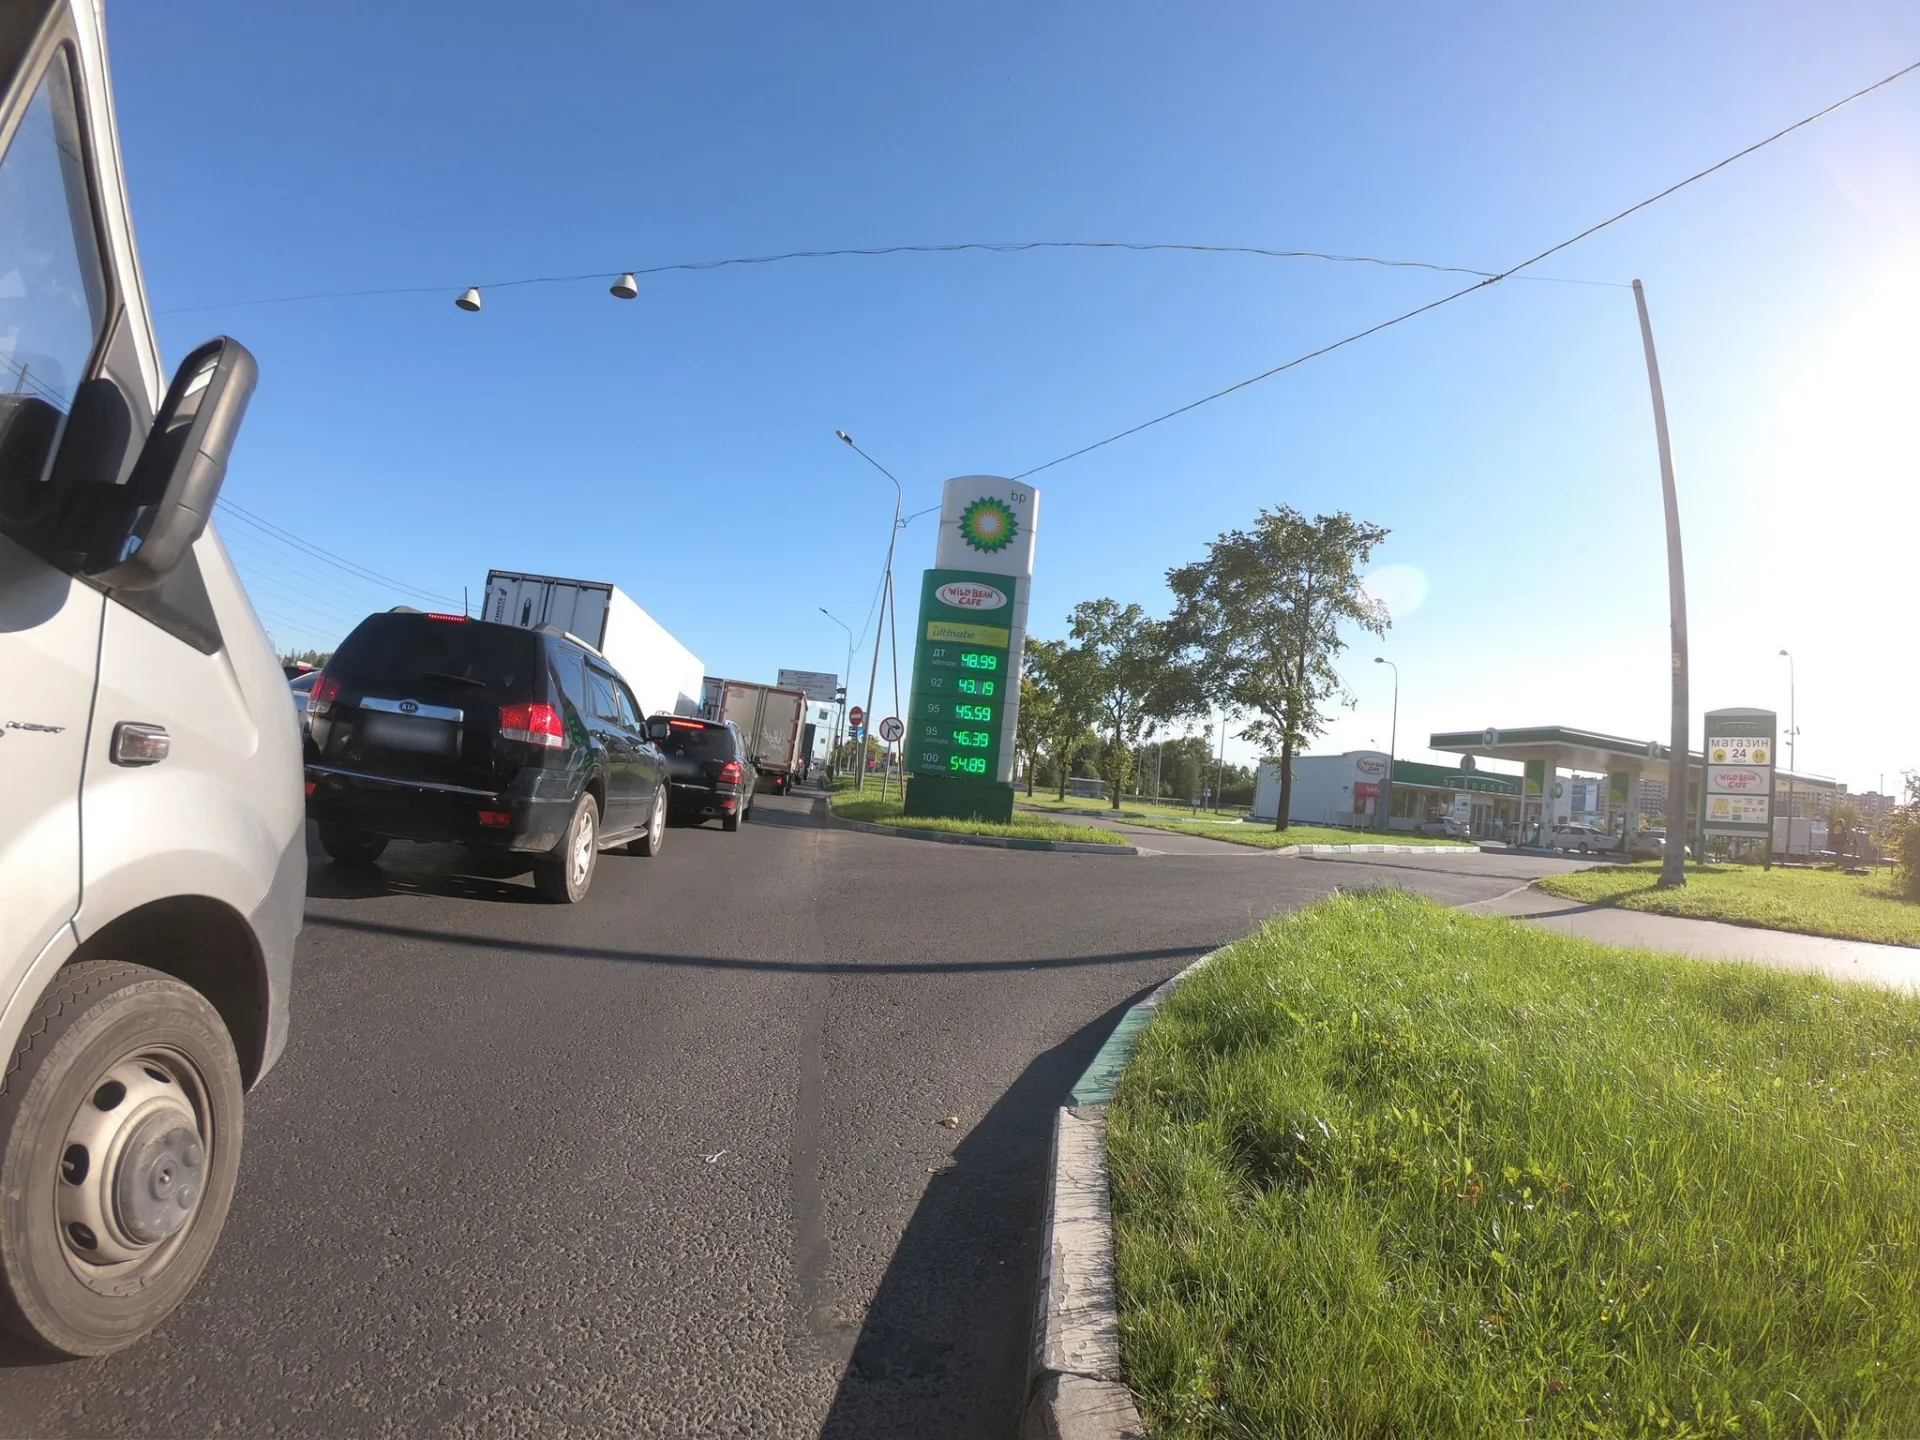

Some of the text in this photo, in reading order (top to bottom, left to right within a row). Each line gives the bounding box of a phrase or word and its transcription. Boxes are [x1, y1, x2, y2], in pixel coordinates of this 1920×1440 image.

[1011, 490, 1027, 504] bp
[972, 588, 994, 599] BEAN
[959, 597, 982, 606] CAFE
[933, 628, 975, 639] ultimate
[933, 649, 946, 657] ДТ
[931, 659, 957, 667] ultimate
[961, 653, 997, 670] 48.99
[931, 678, 994, 696] 92 43.19
[402, 703, 416, 711] KIA
[928, 704, 991, 721] 95 45.59
[925, 726, 989, 747] 95 46.39
[1711, 739, 1769, 748] магазин
[1732, 749, 1747, 758] 24
[923, 752, 986, 773] 100 54.89
[1739, 773, 1756, 782] BEAN
[1444, 777, 1518, 794] bp onnect
[1729, 781, 1747, 789] CAFE
